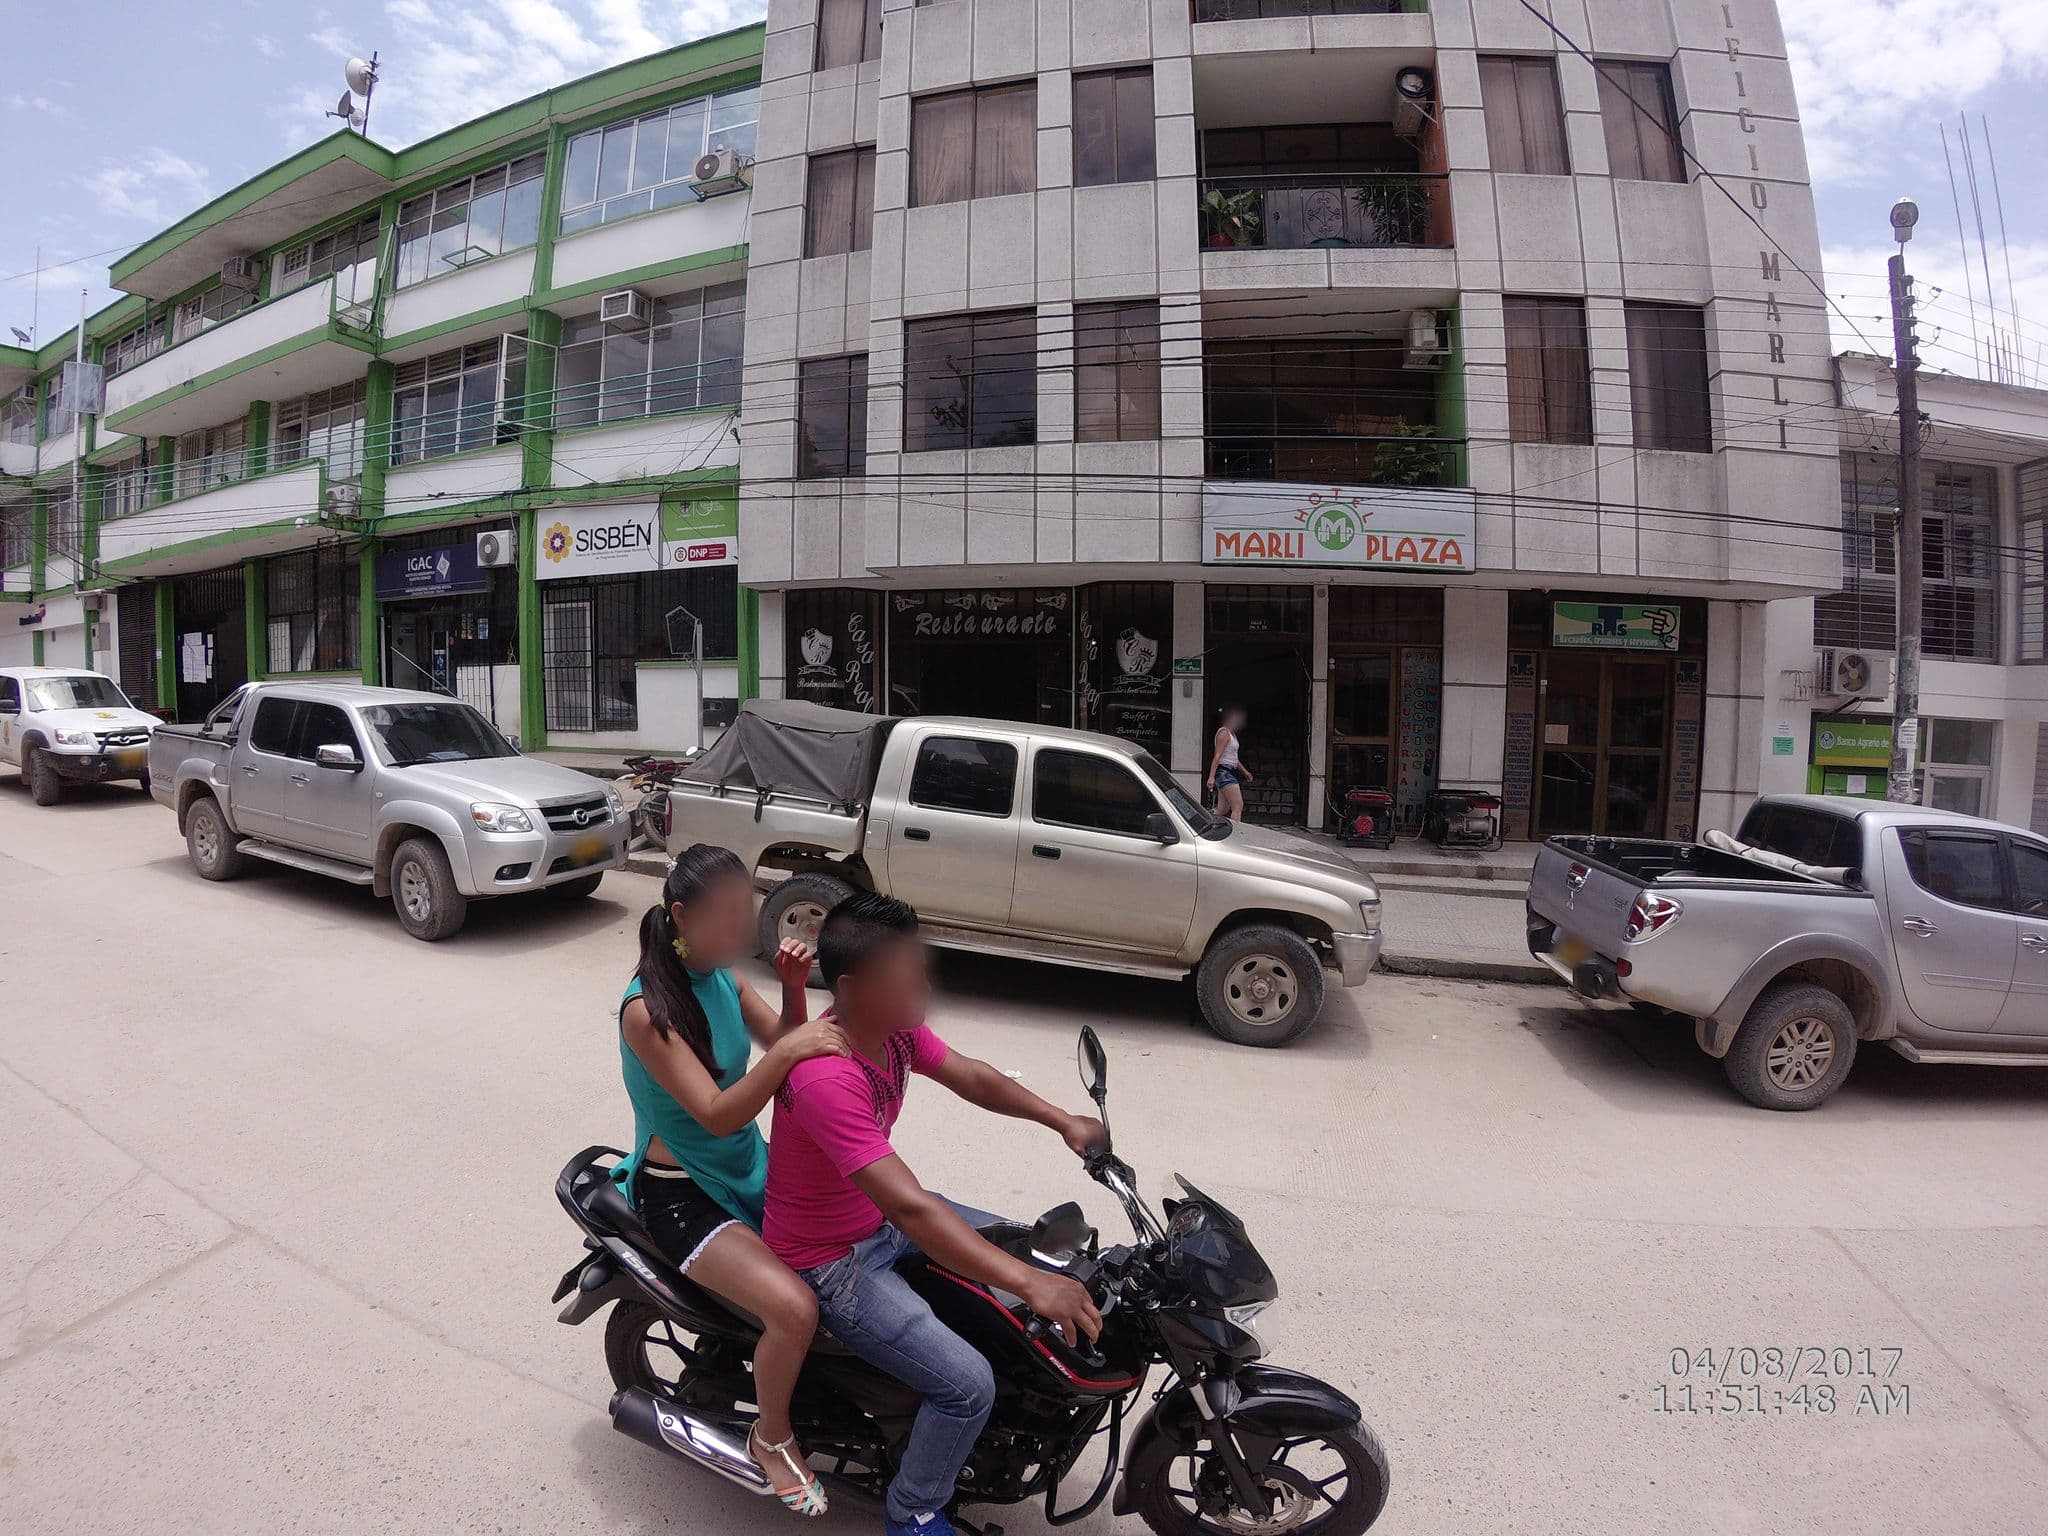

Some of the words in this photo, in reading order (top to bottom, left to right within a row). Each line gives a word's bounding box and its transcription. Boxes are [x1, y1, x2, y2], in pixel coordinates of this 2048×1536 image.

[1760, 251, 1788, 449] MARLI
[1294, 488, 1374, 523] HOTEL
[575, 519, 652, 552] SISBÉN
[1215, 532, 1304, 558] MARLI
[1366, 534, 1463, 565] PLAZA
[407, 555, 433, 572] IGAC
[689, 547, 708, 559] DNP
[847, 612, 875, 664] Casa
[915, 611, 1057, 636] Restaurante
[845, 660, 874, 713] Real
[1121, 711, 1157, 723] Buffet's
[1400, 653, 1413, 787] PERFUMERIA
[1836, 736, 1856, 746] Banco
[1857, 737, 1879, 749] Agrario
[1880, 738, 1889, 748] de
[622, 1251, 657, 1280] 150
